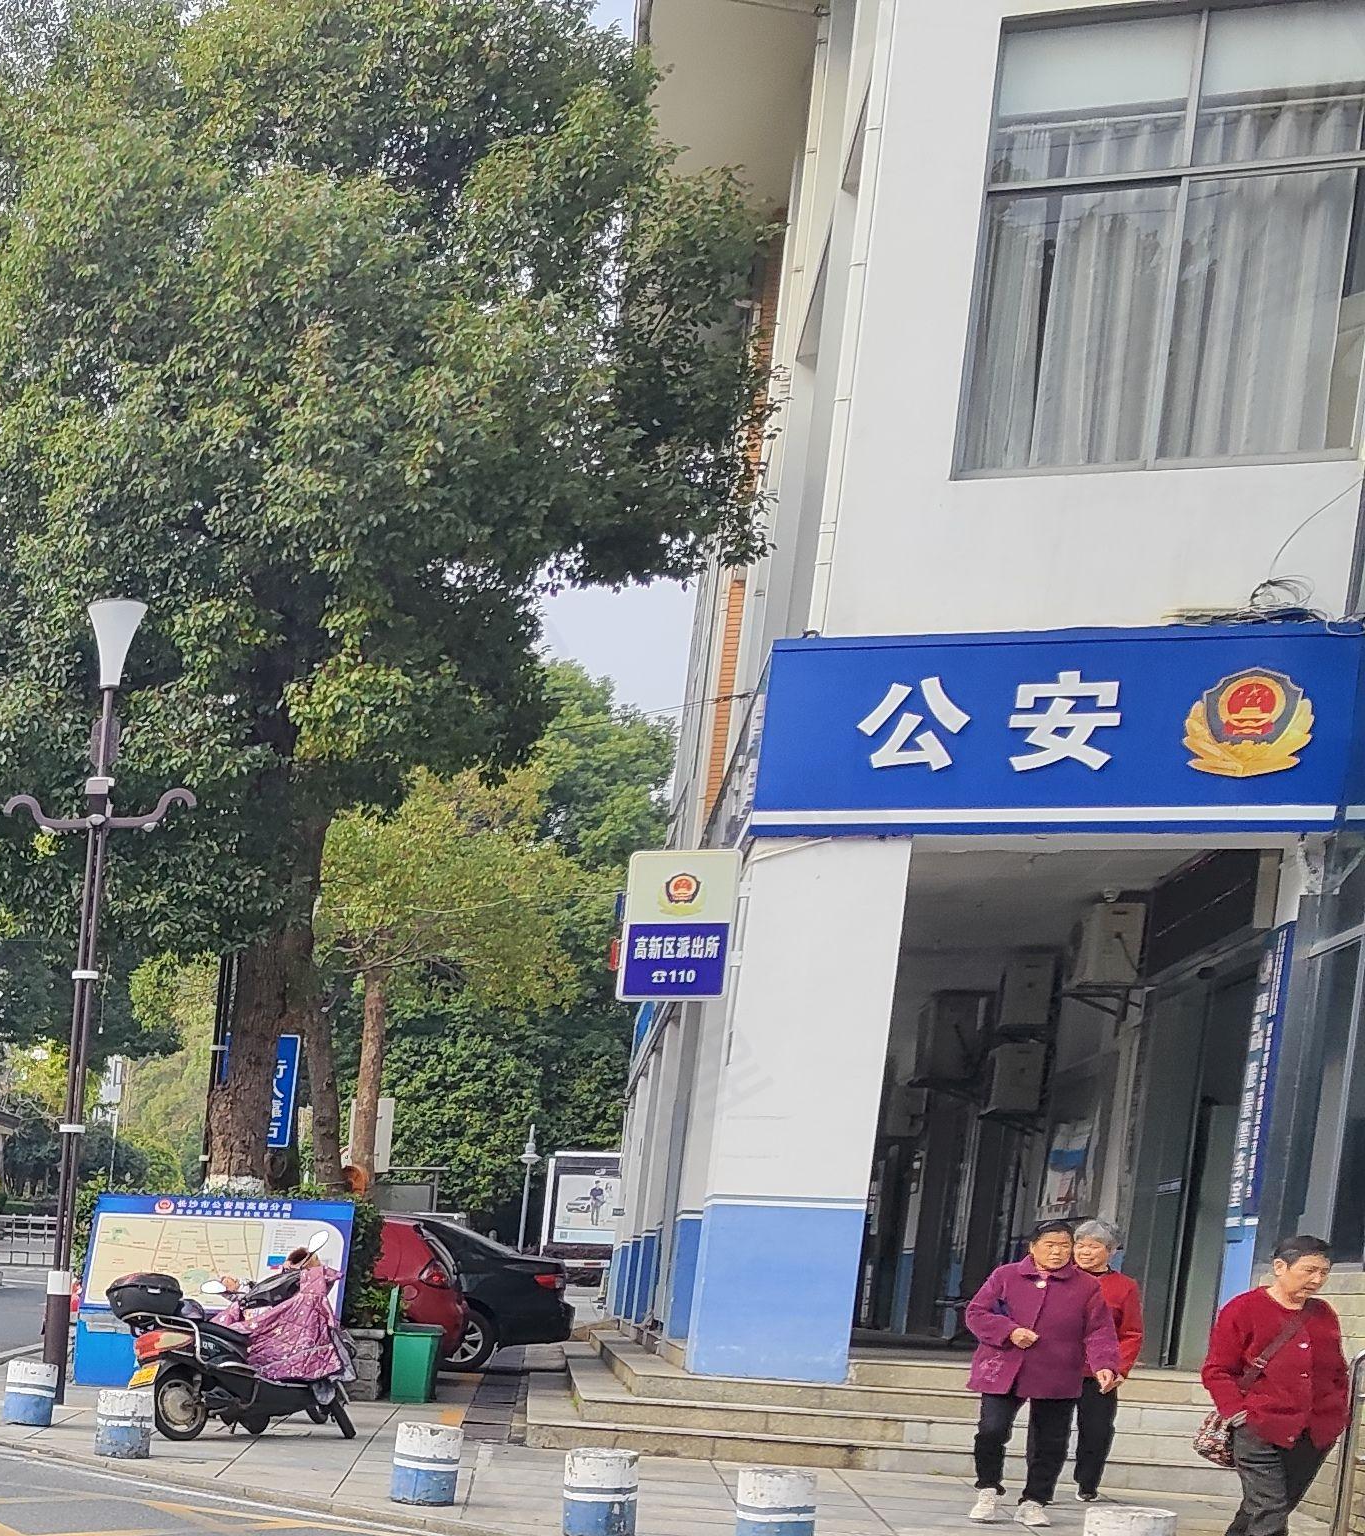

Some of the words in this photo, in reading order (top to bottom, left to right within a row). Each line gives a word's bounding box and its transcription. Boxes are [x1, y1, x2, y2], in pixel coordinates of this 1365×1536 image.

[856, 670, 1122, 772] 公安
[633, 935, 720, 960] 高新区派出所
[668, 969, 697, 983] 110
